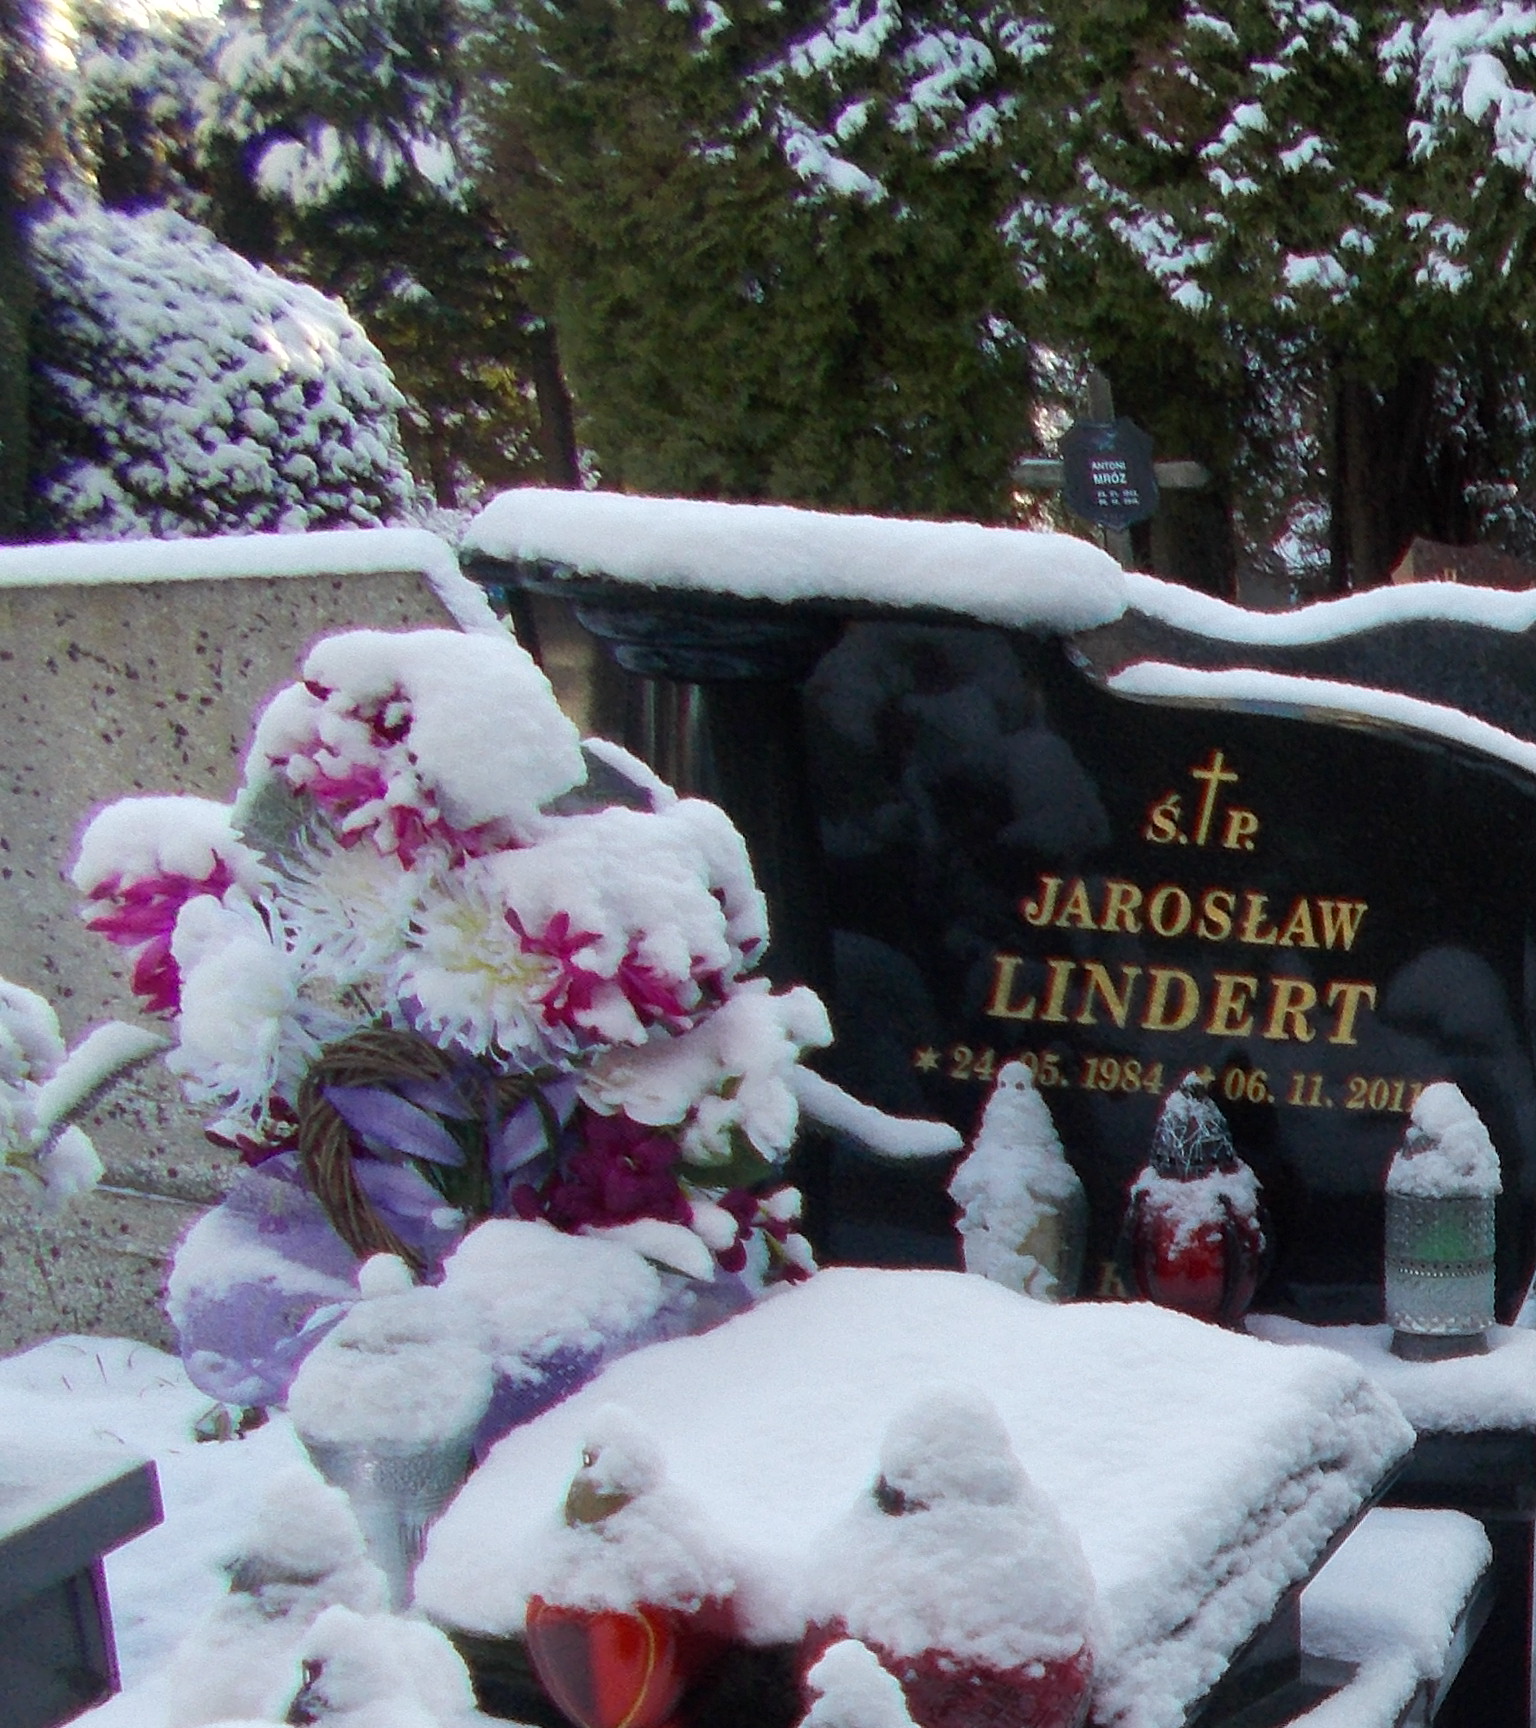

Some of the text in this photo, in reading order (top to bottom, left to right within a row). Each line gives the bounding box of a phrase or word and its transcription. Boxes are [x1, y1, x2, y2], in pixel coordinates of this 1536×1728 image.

[1092, 461, 1126, 471] ANTONI
[1093, 471, 1127, 485] MRÓZ
[1024, 874, 1369, 952] JAROSŁAW
[986, 955, 1377, 1047] LINDERT
[1082, 1057, 1164, 1094] 1984
[1224, 1067, 1276, 1104] 06.
[1288, 1073, 1334, 1108] 11.
